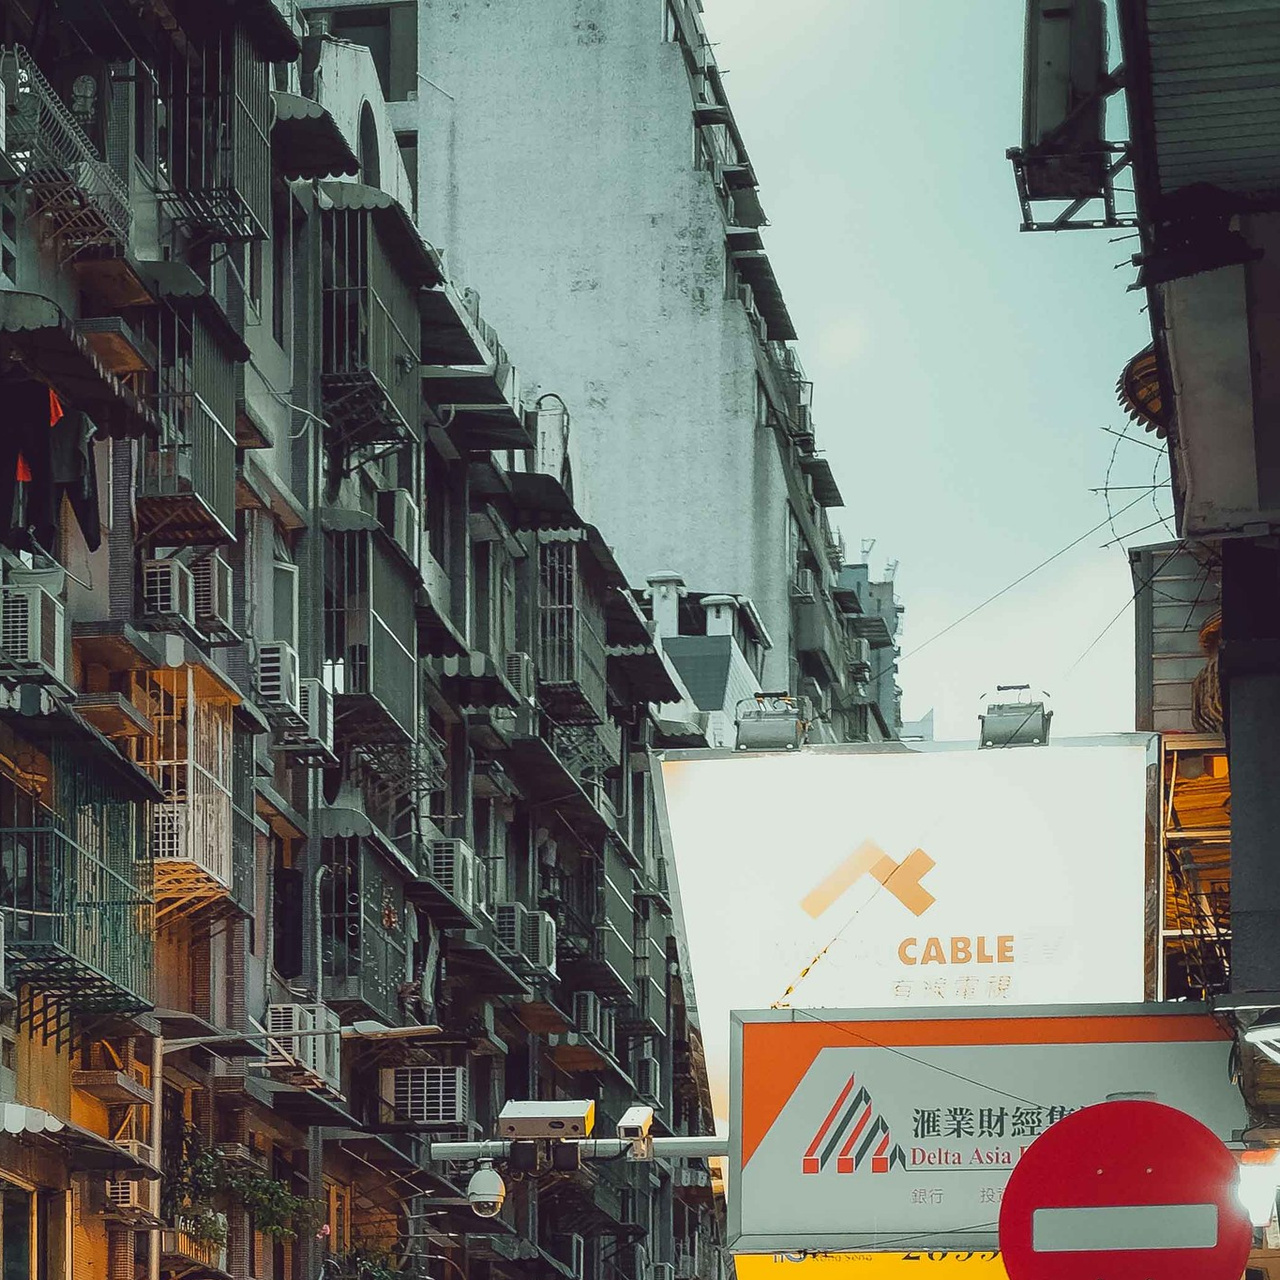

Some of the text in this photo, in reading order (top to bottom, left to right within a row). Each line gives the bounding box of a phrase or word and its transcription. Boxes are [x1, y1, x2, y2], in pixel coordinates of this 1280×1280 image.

[898, 935, 1014, 966] CABLE
[910, 1147, 962, 1166] Delta
[969, 1147, 1012, 1165] Asia
[911, 1188, 944, 1205] 銀行
